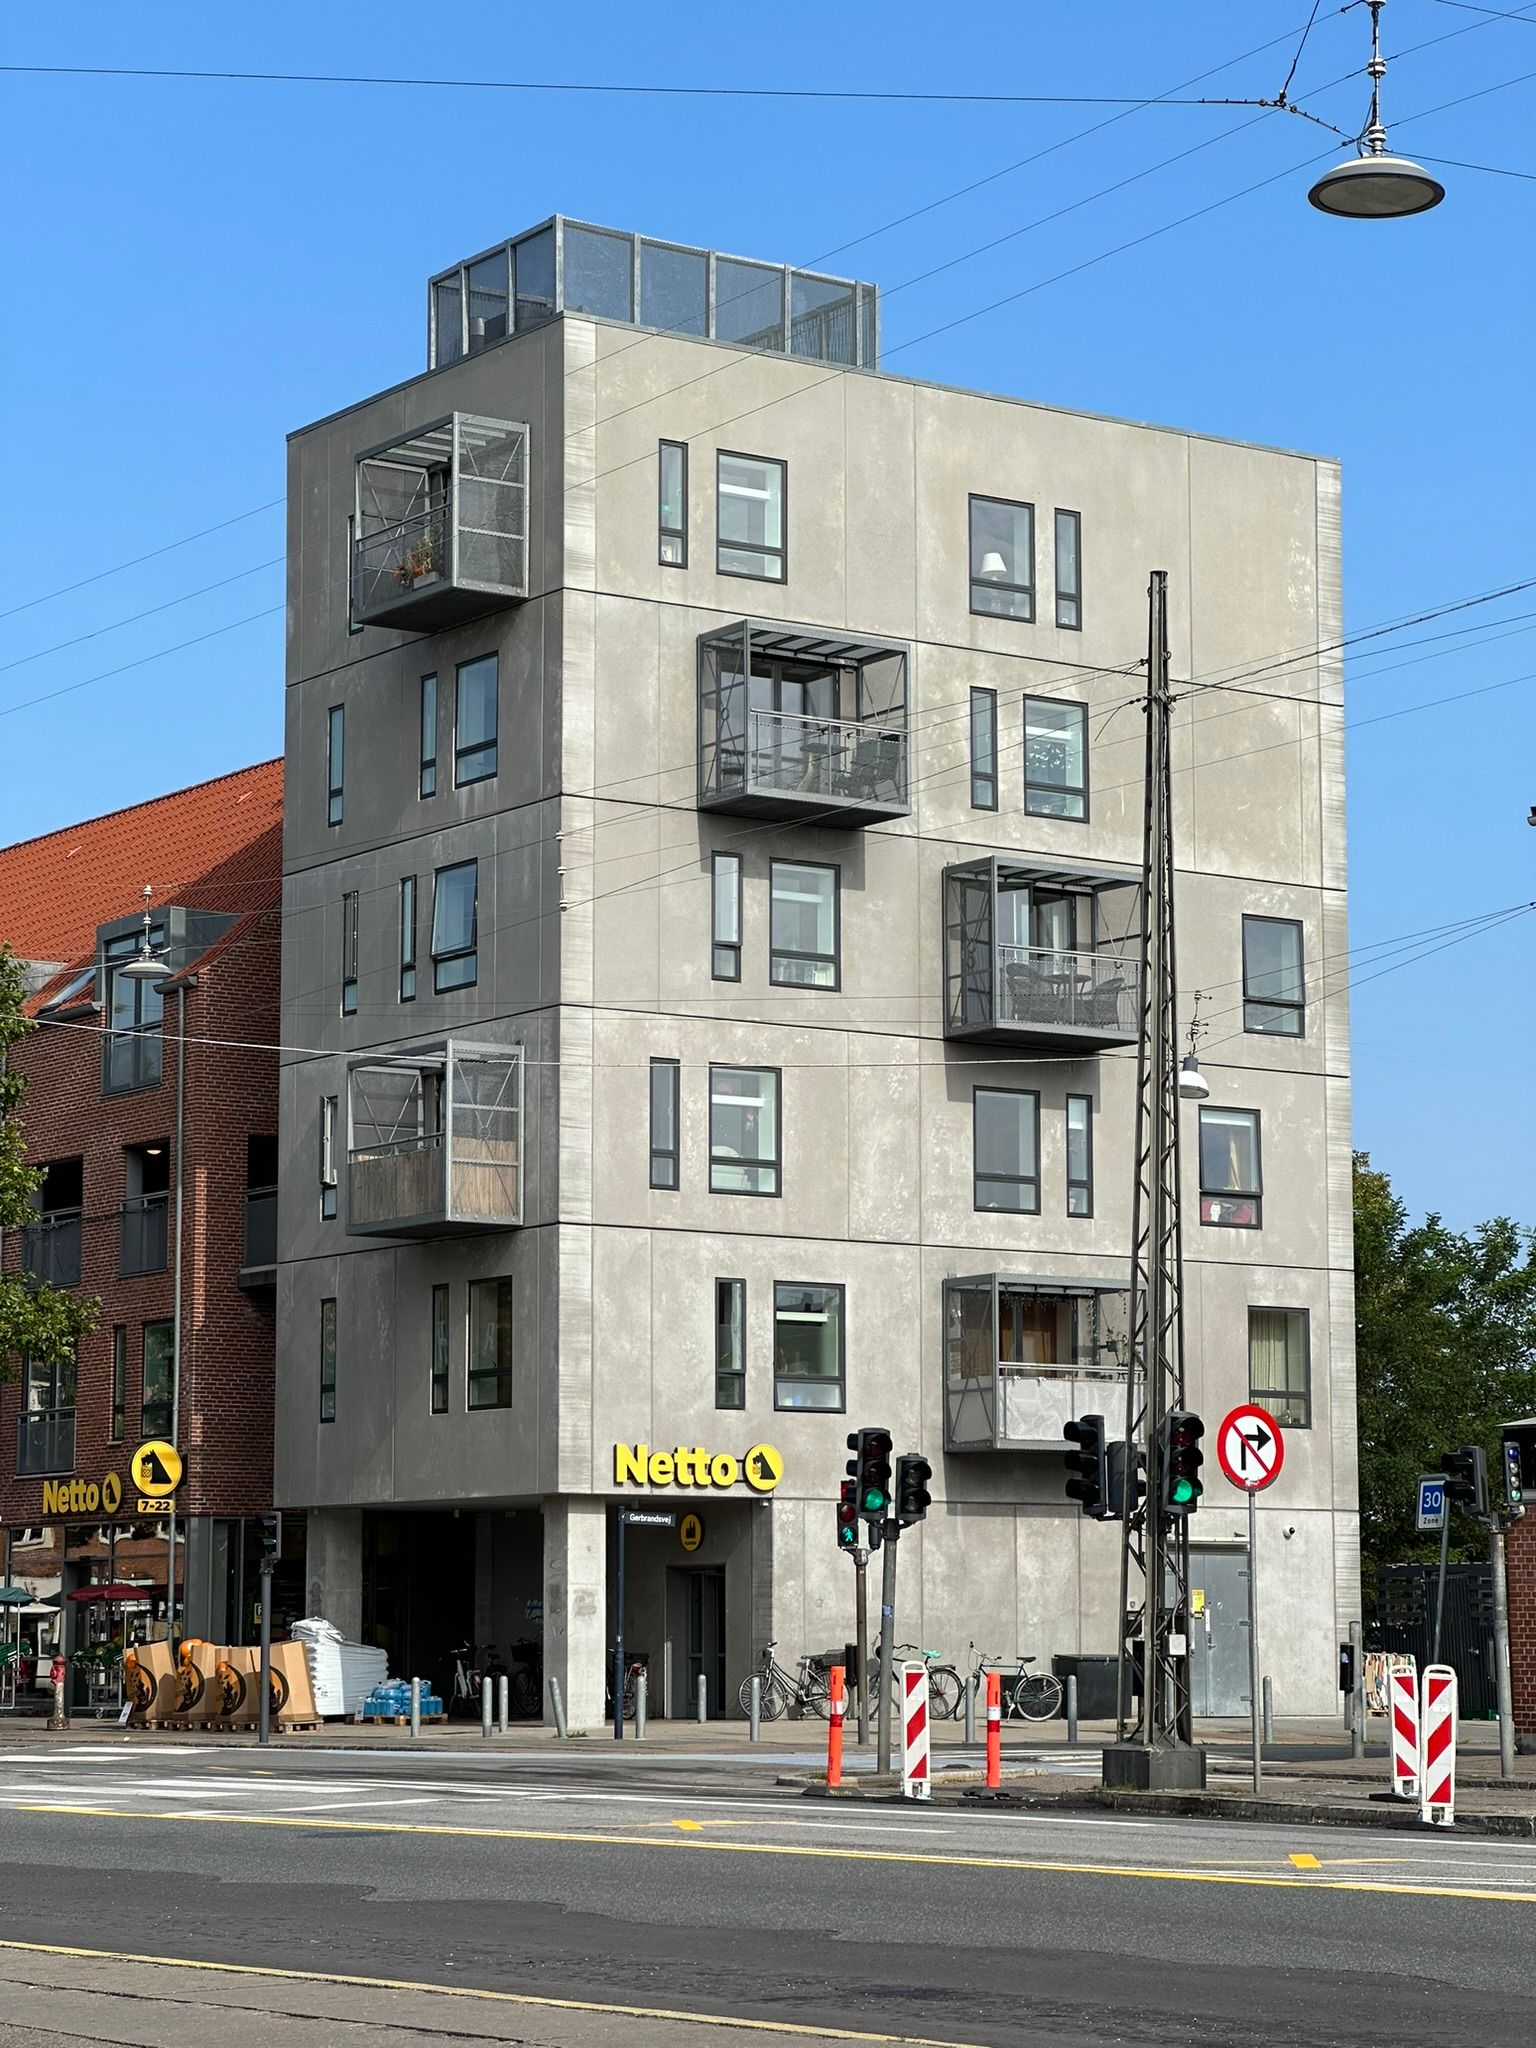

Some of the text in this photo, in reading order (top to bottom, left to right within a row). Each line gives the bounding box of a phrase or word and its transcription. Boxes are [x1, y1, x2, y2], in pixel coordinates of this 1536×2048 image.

[615, 1443, 738, 1486] Netto
[42, 1479, 99, 1513] Netto
[1423, 1491, 1441, 1507] 30
[141, 1500, 170, 1511] 7-22
[629, 1513, 672, 1525] Gerbrandsvej
